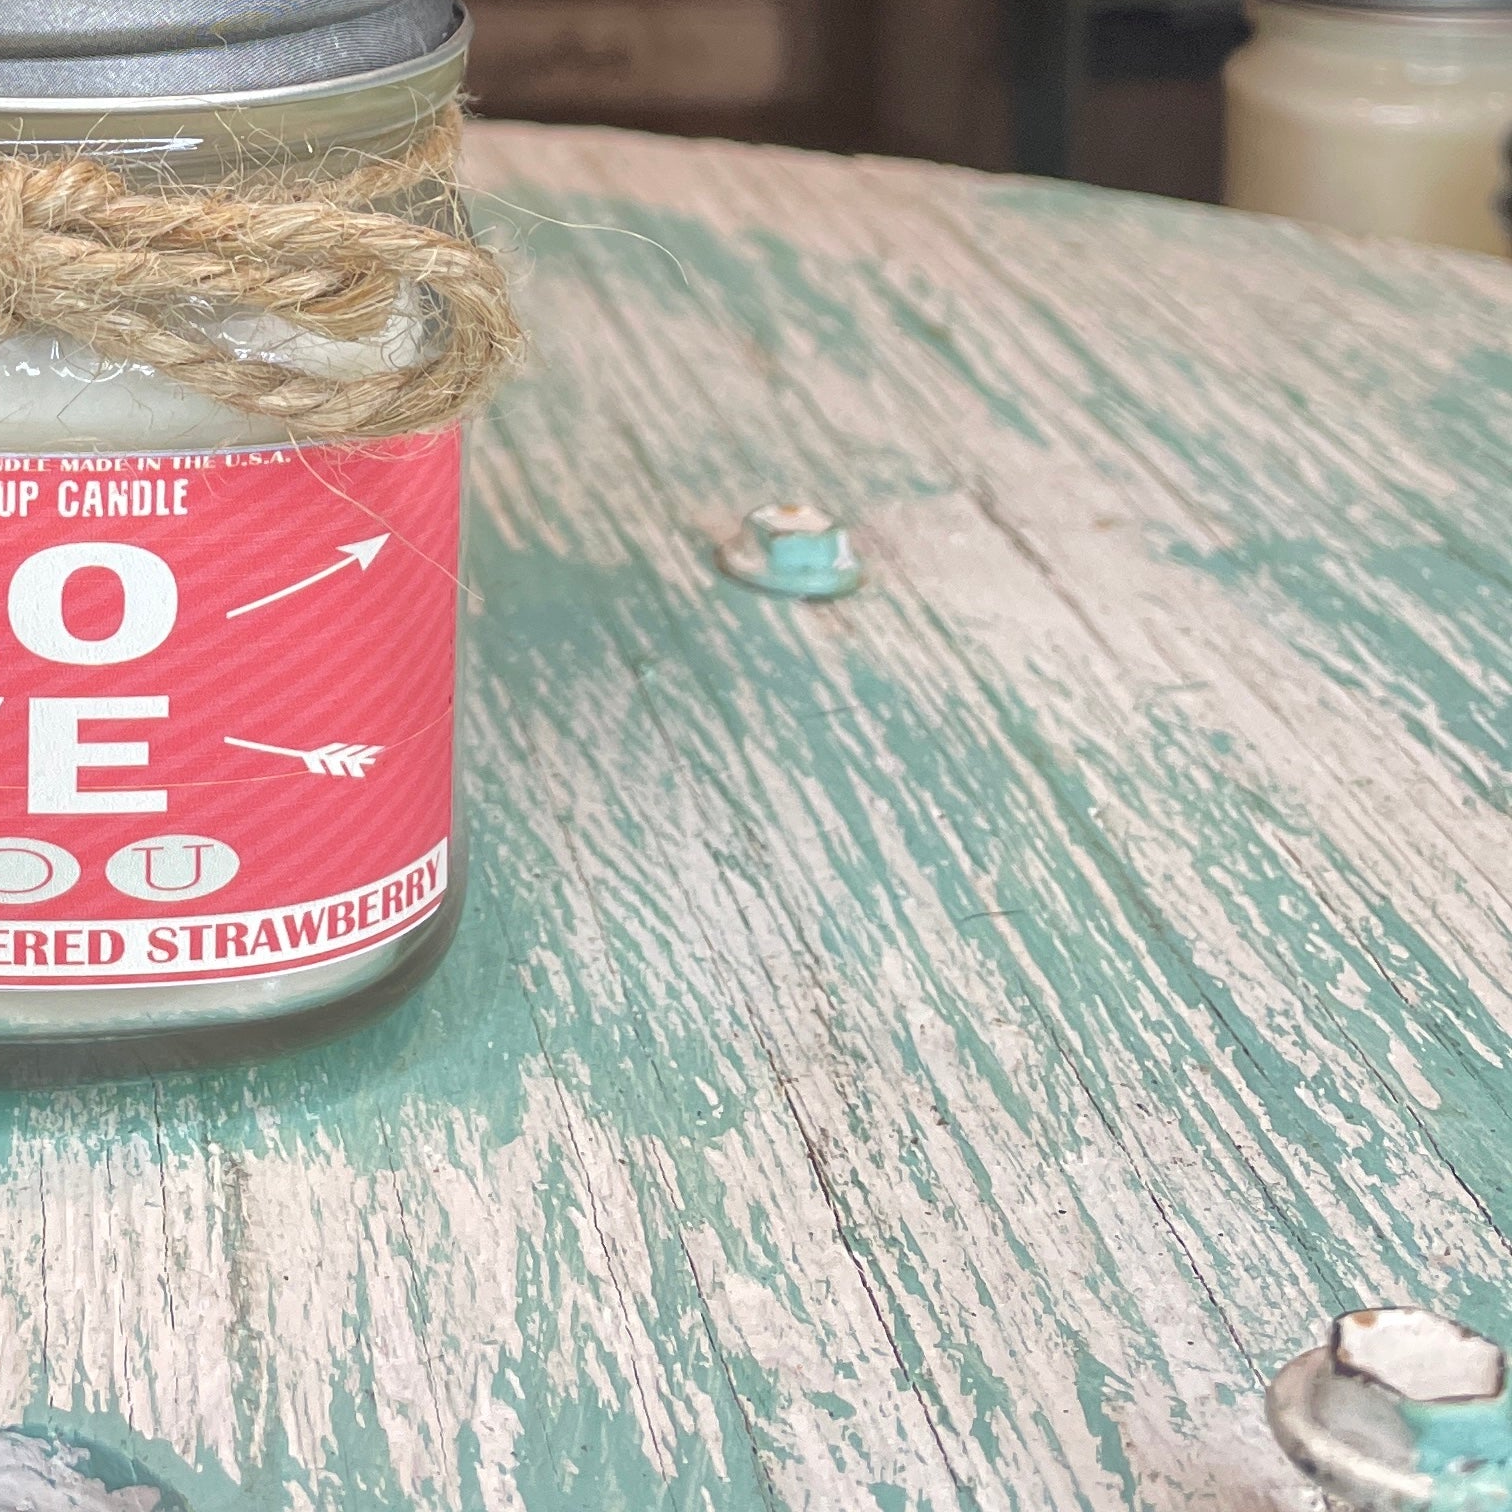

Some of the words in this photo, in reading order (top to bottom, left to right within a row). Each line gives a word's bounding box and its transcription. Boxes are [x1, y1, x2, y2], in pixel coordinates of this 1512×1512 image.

[60, 458, 129, 472] MADE
[137, 457, 162, 471] IN
[172, 455, 216, 469] THE
[57, 477, 189, 518] CANDLE
[146, 850, 441, 964] STRAWBERRY
